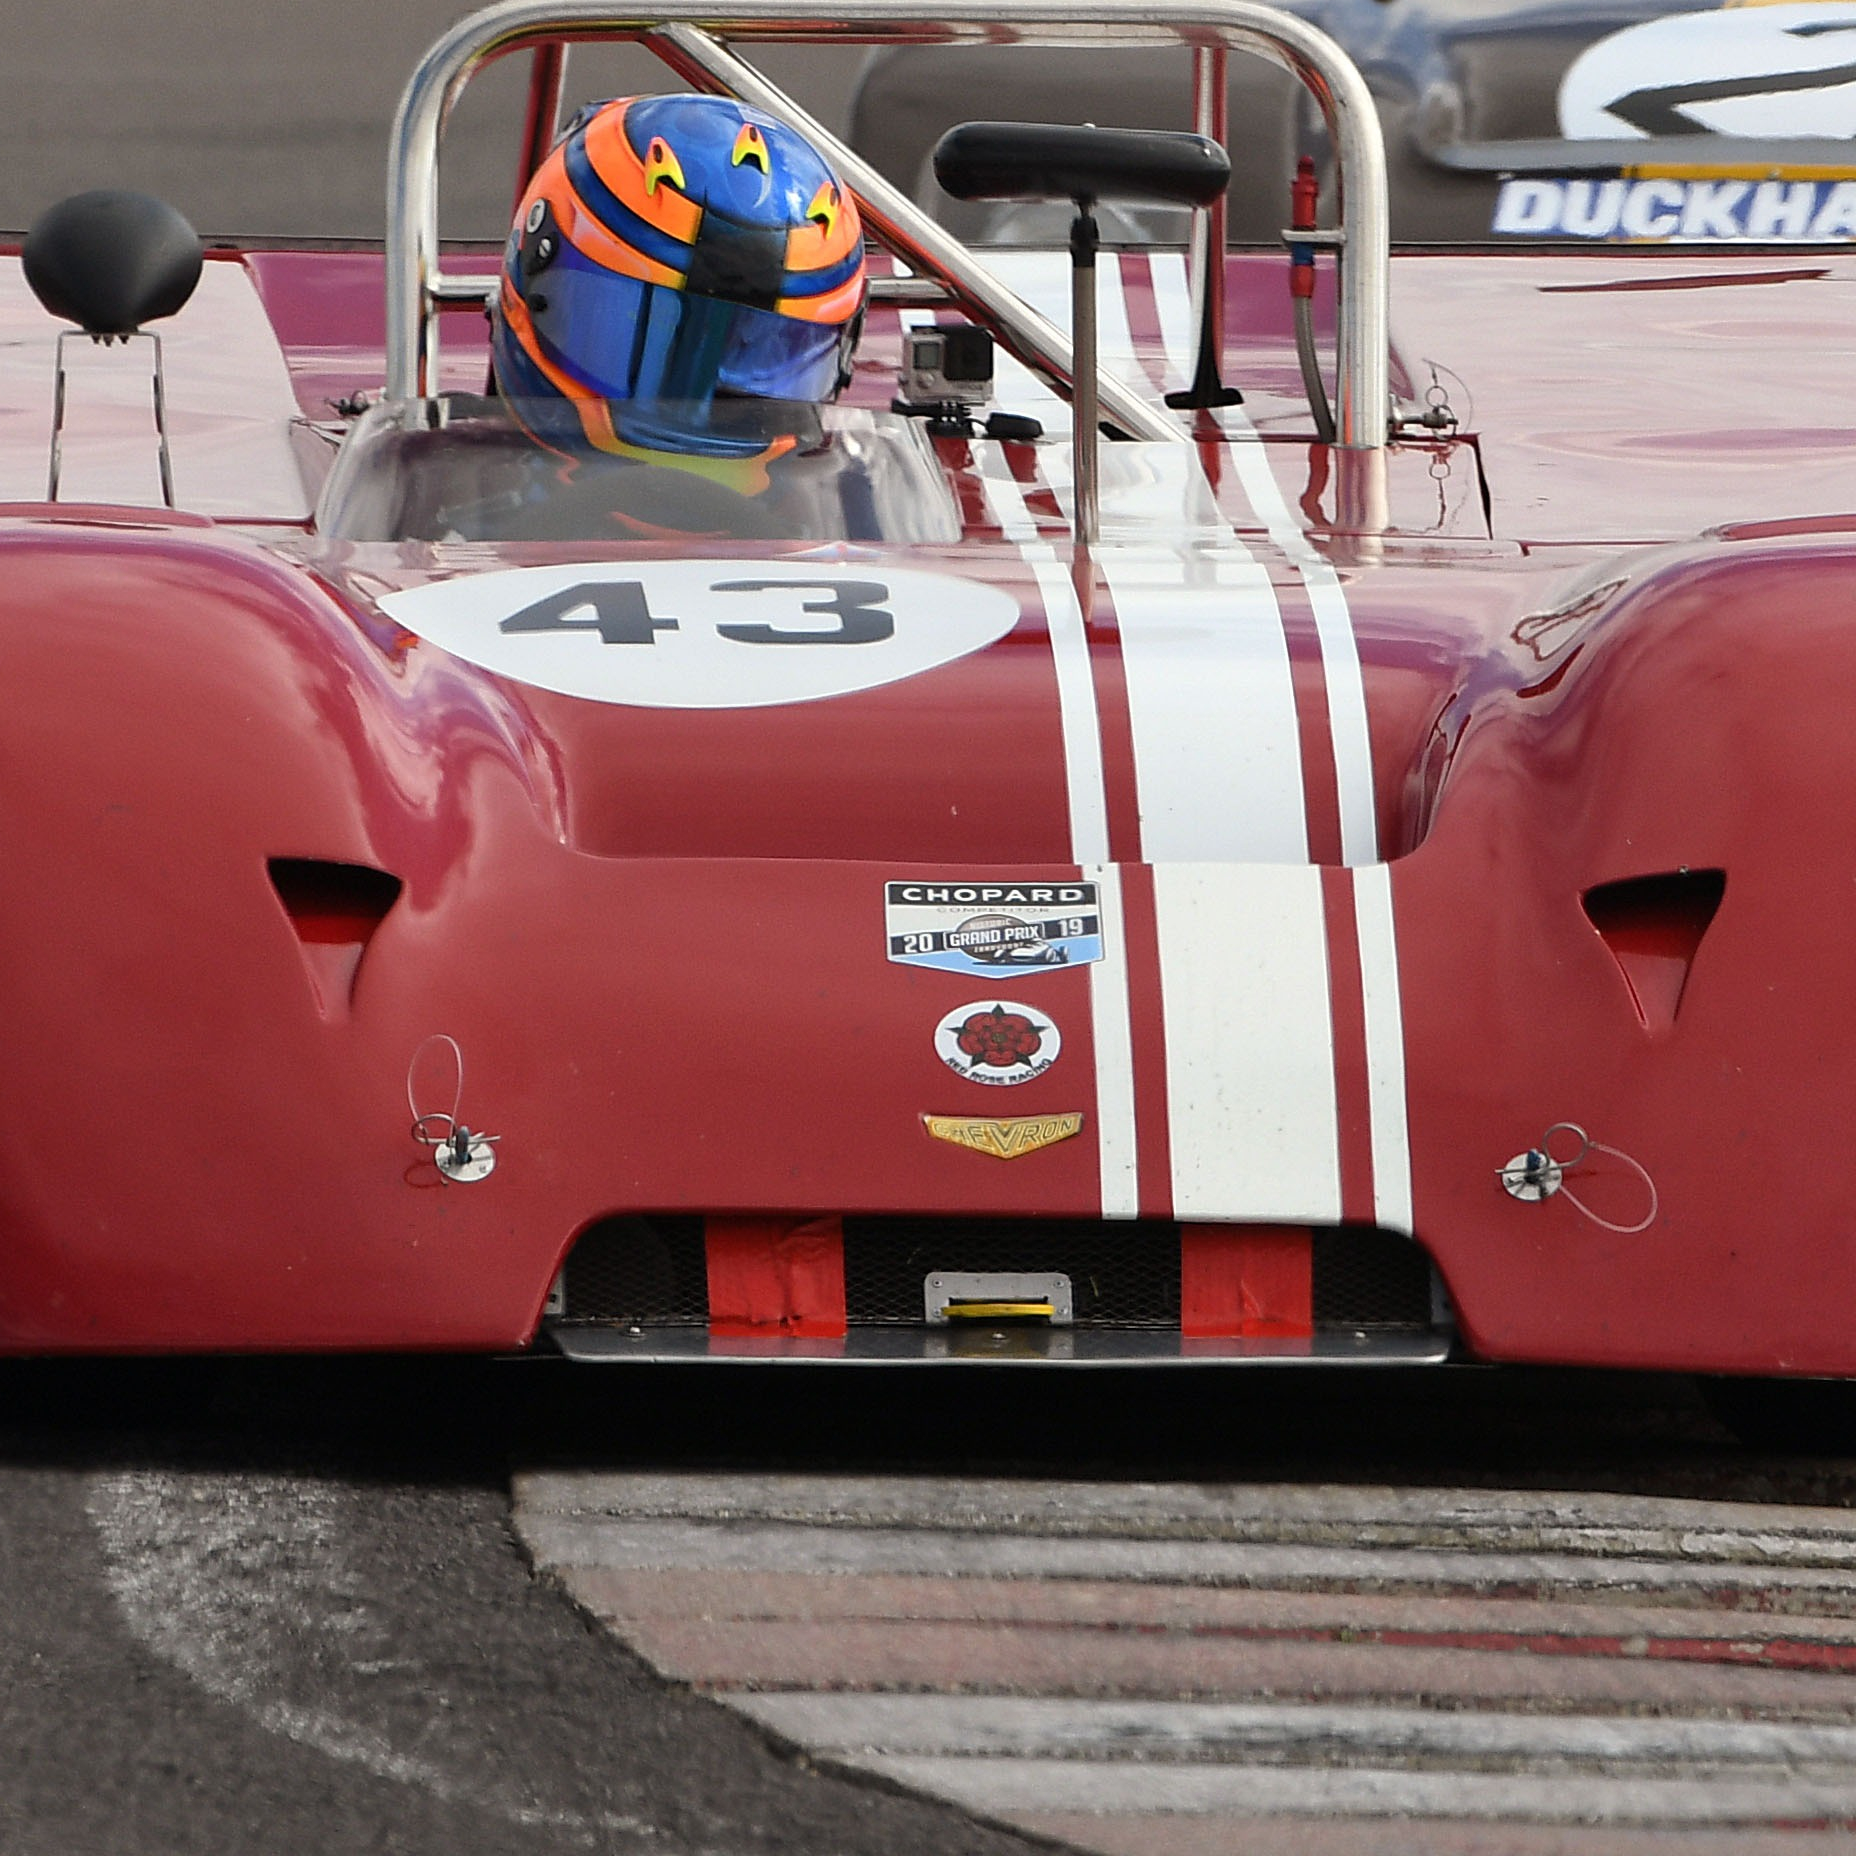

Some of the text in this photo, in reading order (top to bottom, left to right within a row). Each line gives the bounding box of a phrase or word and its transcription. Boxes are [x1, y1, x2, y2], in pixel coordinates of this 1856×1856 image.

[497, 578, 896, 646] 43
[901, 887, 1085, 903] CHOPARD
[936, 906, 1050, 914] COMPETITOR
[948, 924, 1041, 948] GRAND PRIX
[1058, 918, 1084, 937] 19
[903, 933, 933, 954] 20
[945, 1056, 1054, 1085] RED ROSE RACING
[933, 1117, 1074, 1153] CHEVRON
